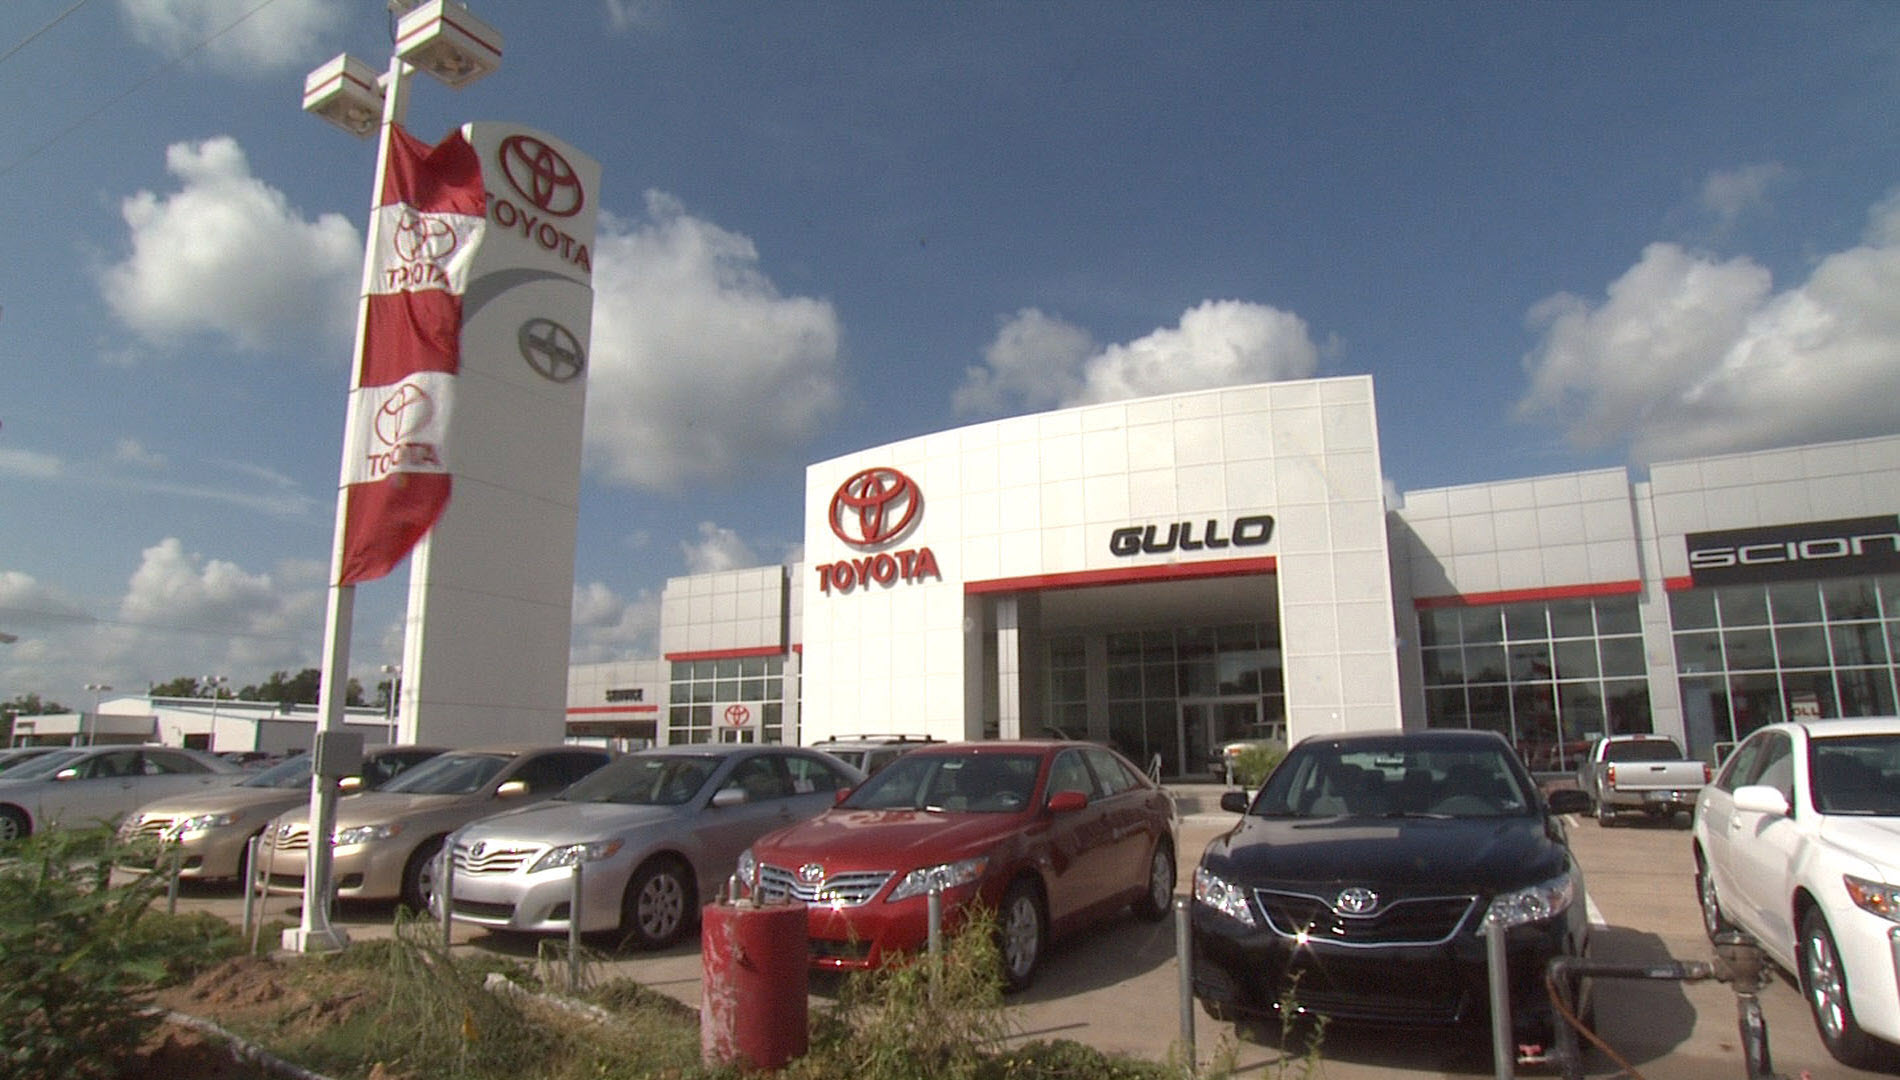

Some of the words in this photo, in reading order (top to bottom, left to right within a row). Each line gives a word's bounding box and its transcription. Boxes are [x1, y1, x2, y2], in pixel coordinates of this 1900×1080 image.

[1110, 515, 1275, 557] GULLO
[1689, 532, 1900, 569] SCION
[815, 547, 940, 593] TOYOTA
